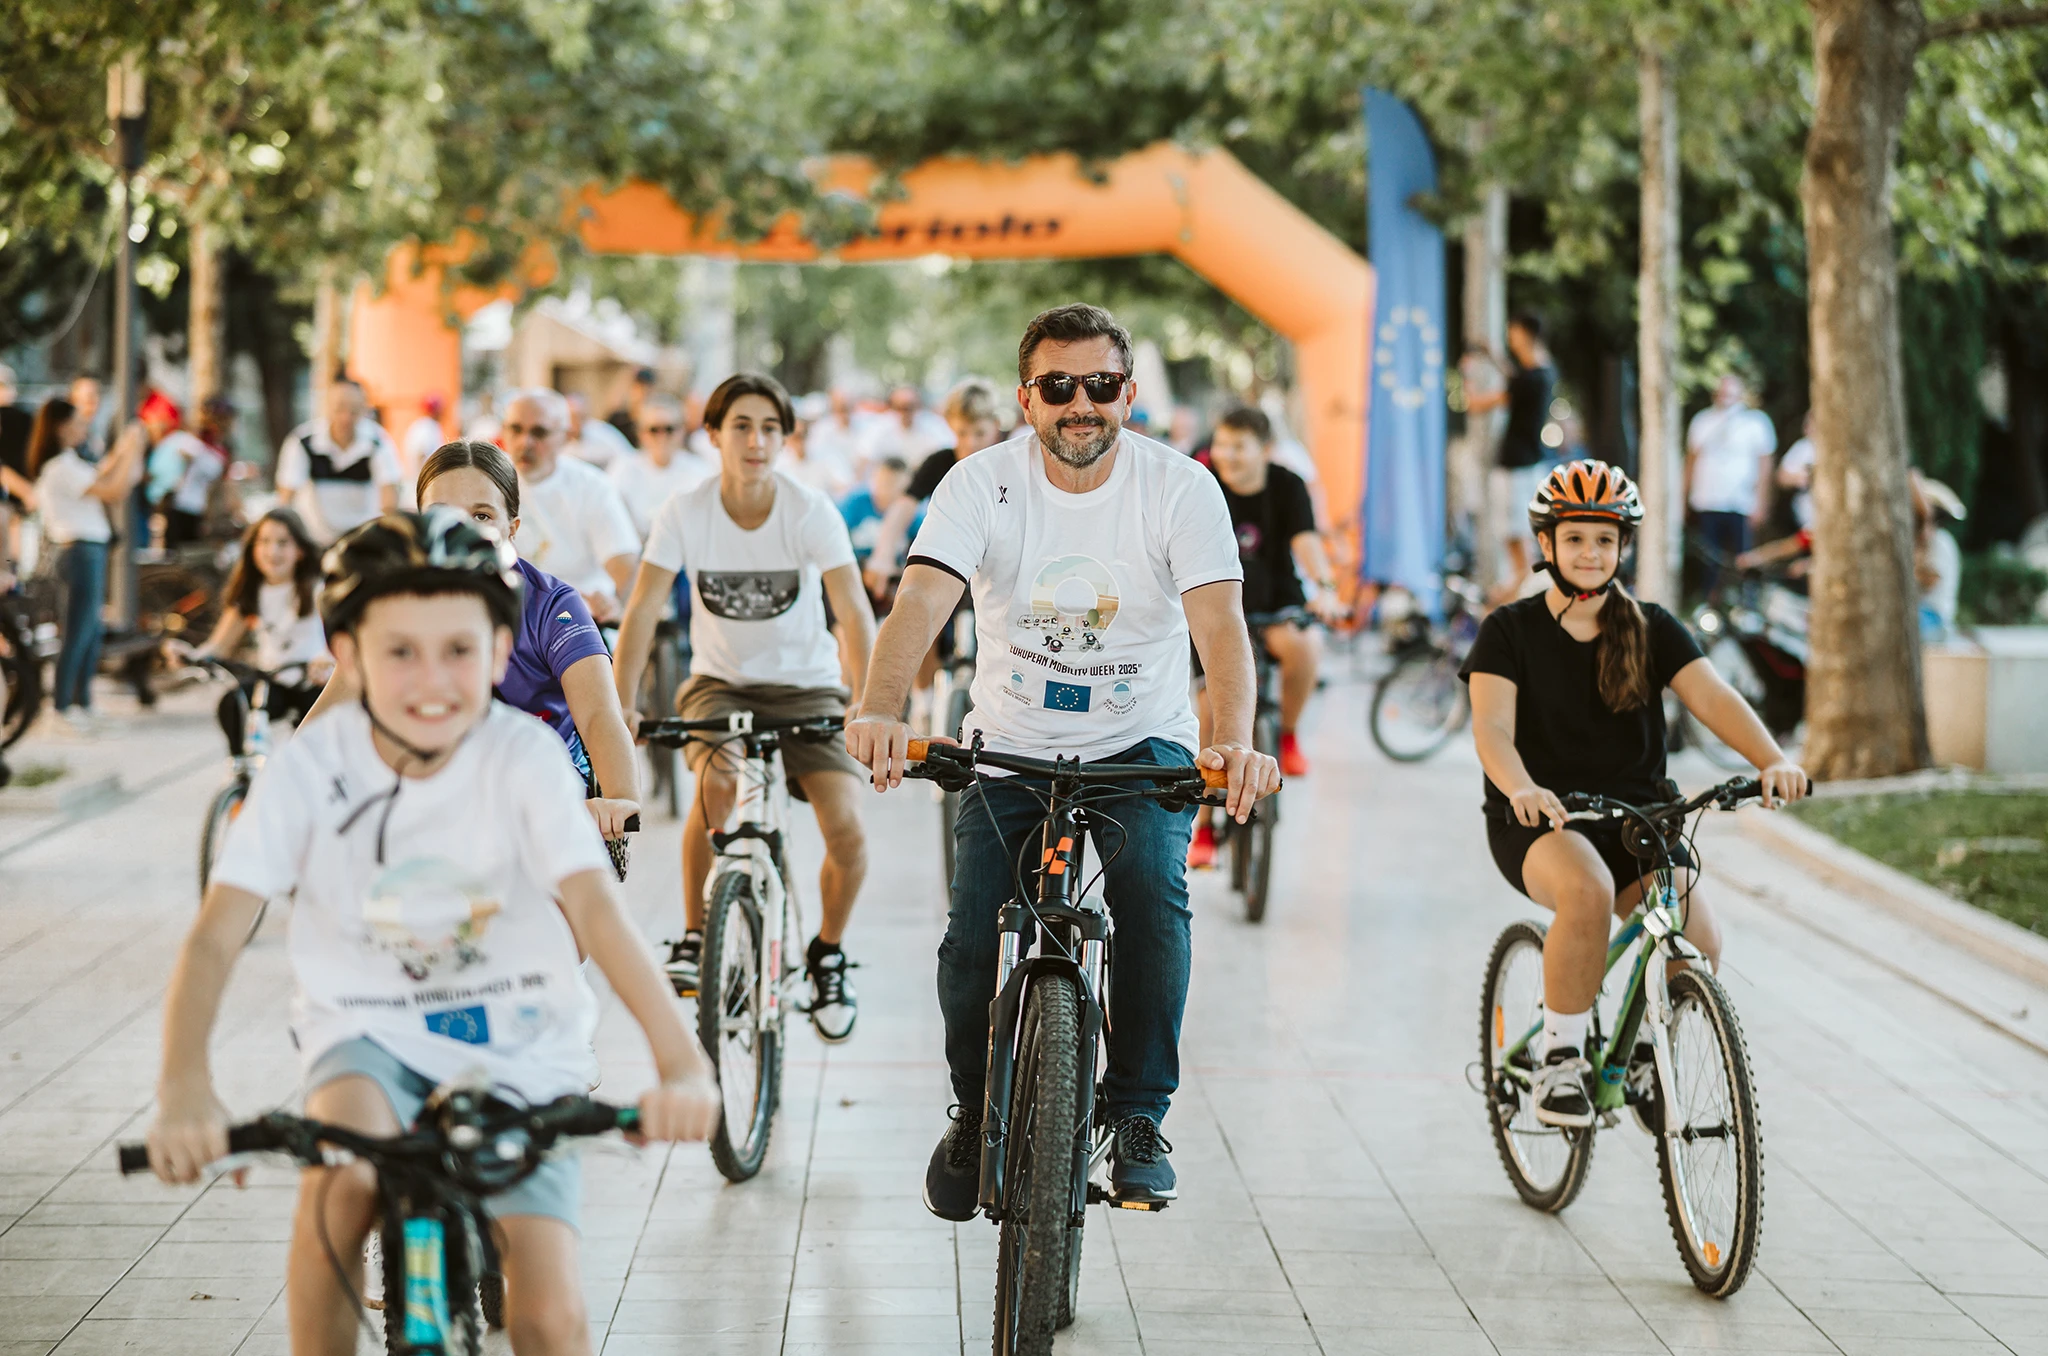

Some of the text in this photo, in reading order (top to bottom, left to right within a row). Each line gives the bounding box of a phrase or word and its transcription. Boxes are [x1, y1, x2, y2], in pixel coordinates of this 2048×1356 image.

[1048, 659, 1087, 676] MOBILITY
[1090, 664, 1115, 676] WEEK
[1103, 702, 1113, 712] CITY
[1106, 698, 1119, 709] GRAD
